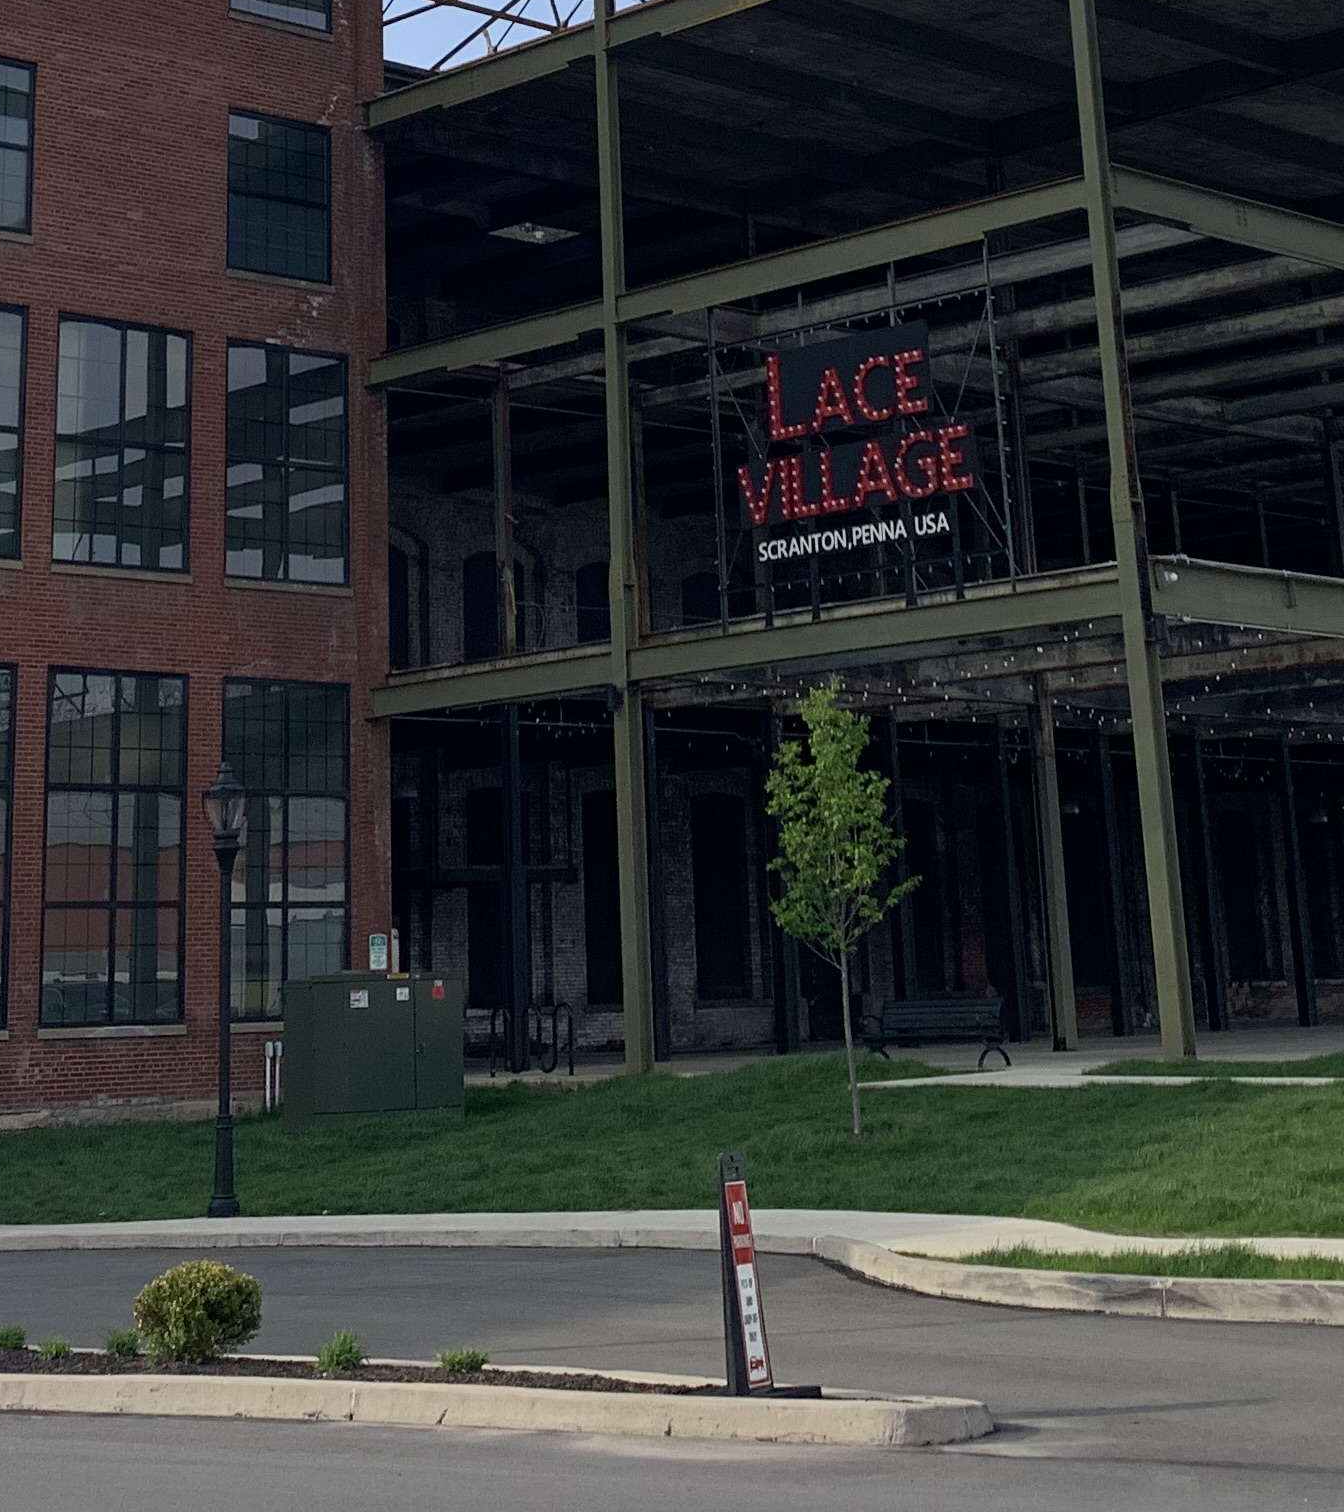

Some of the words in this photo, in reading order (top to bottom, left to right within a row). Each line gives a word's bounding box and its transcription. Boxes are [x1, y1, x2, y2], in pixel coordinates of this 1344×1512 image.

[766, 348, 929, 440] LACE
[737, 422, 974, 526] VILLAGE
[914, 511, 950, 536] USA
